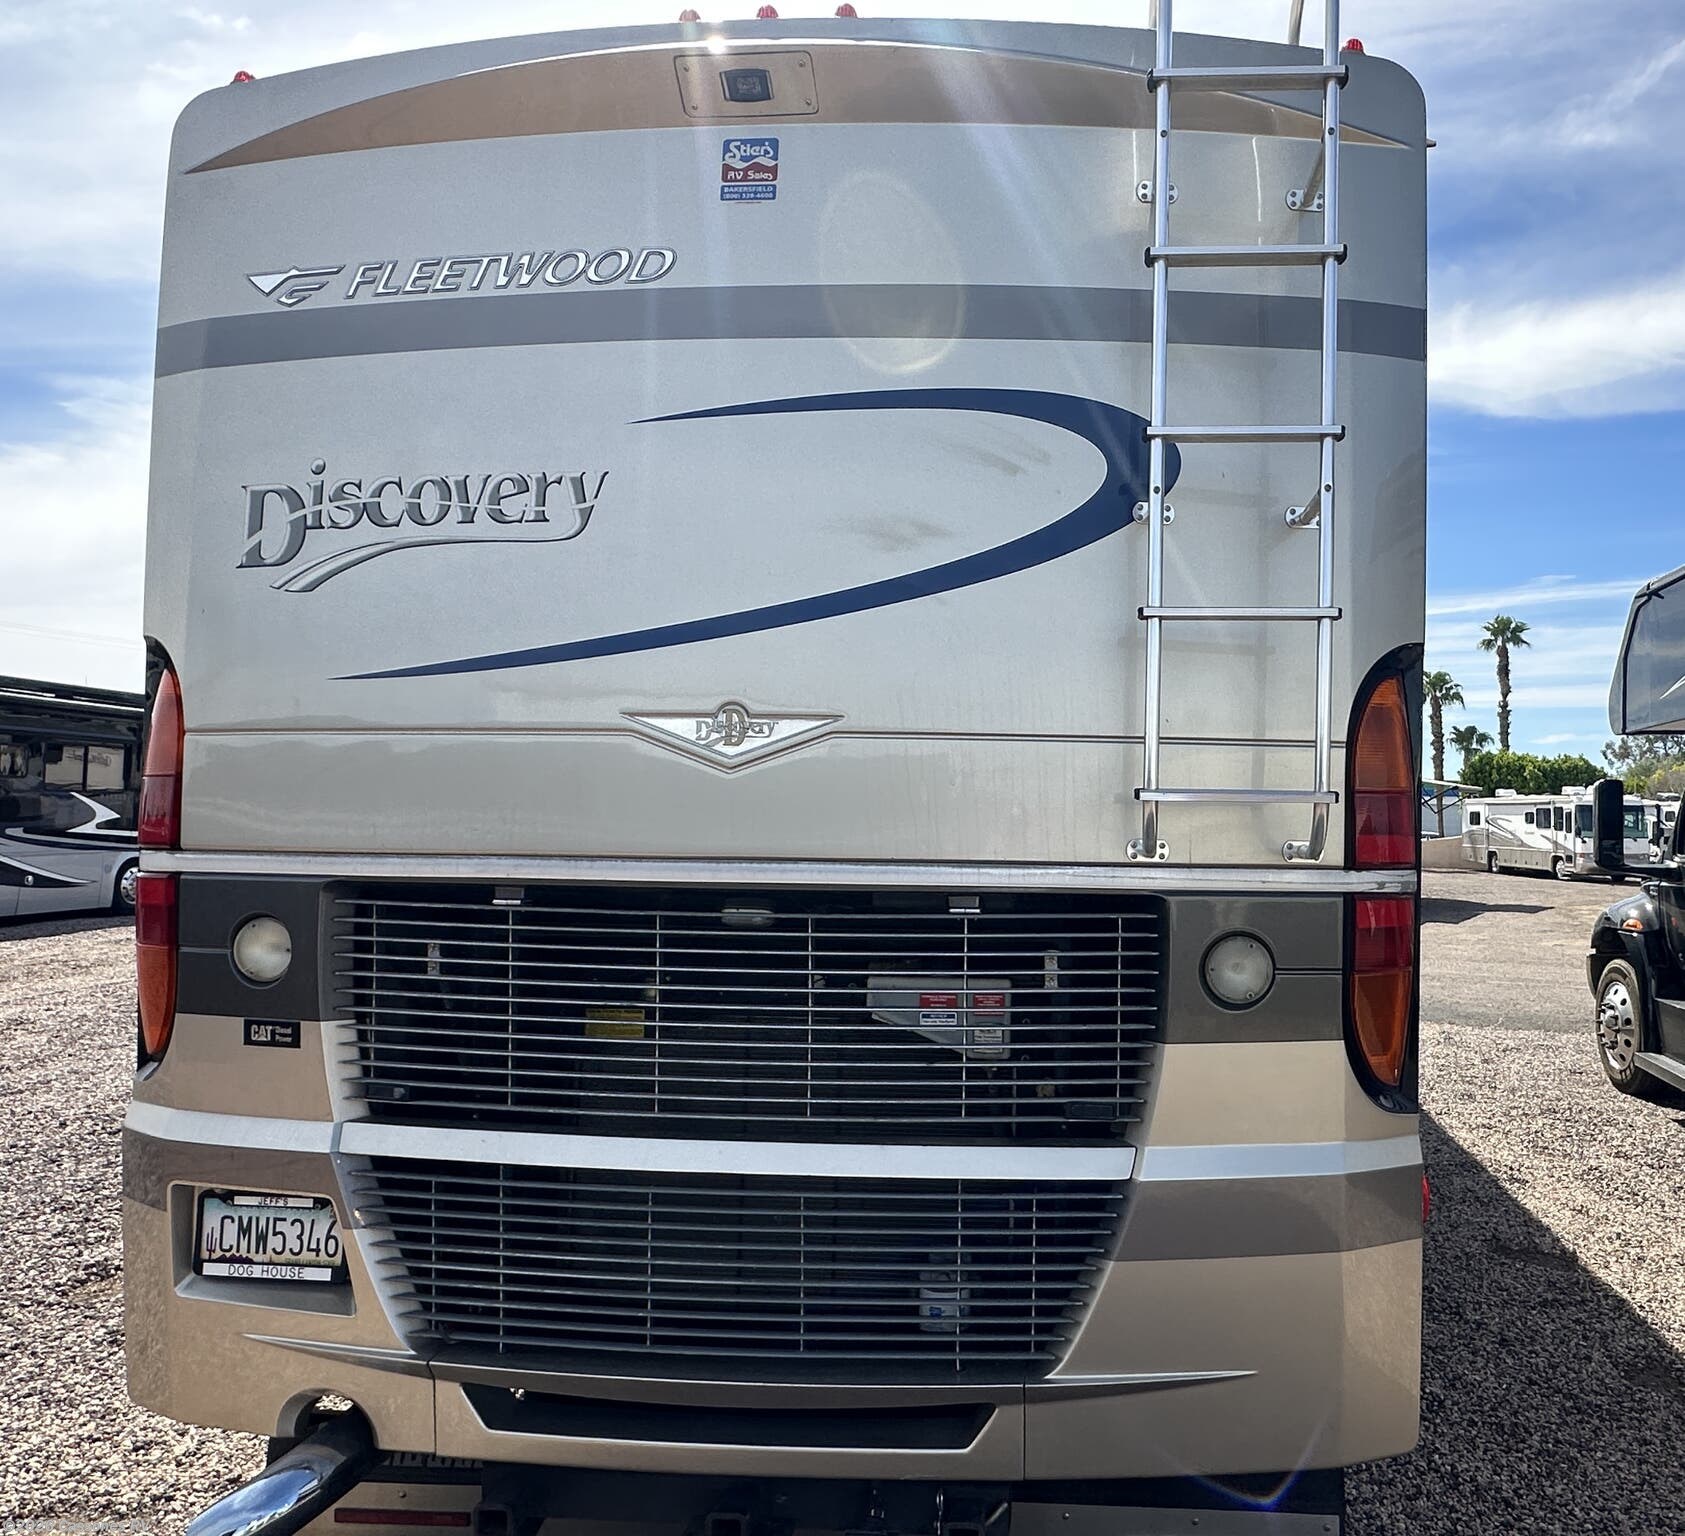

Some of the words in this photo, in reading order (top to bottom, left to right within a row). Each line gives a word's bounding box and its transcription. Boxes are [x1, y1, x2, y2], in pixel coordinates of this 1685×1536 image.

[727, 171, 744, 180] RV
[747, 170, 773, 180] Sales
[344, 247, 677, 299] FLEETWOOD
[236, 457, 609, 592] Discovery
[251, 1024, 273, 1041] CAT
[258, 1197, 289, 1206] JEFF'S
[219, 1215, 339, 1258] CMW5346
[228, 1264, 254, 1276] DOG
[261, 1266, 305, 1279] HOUSE
